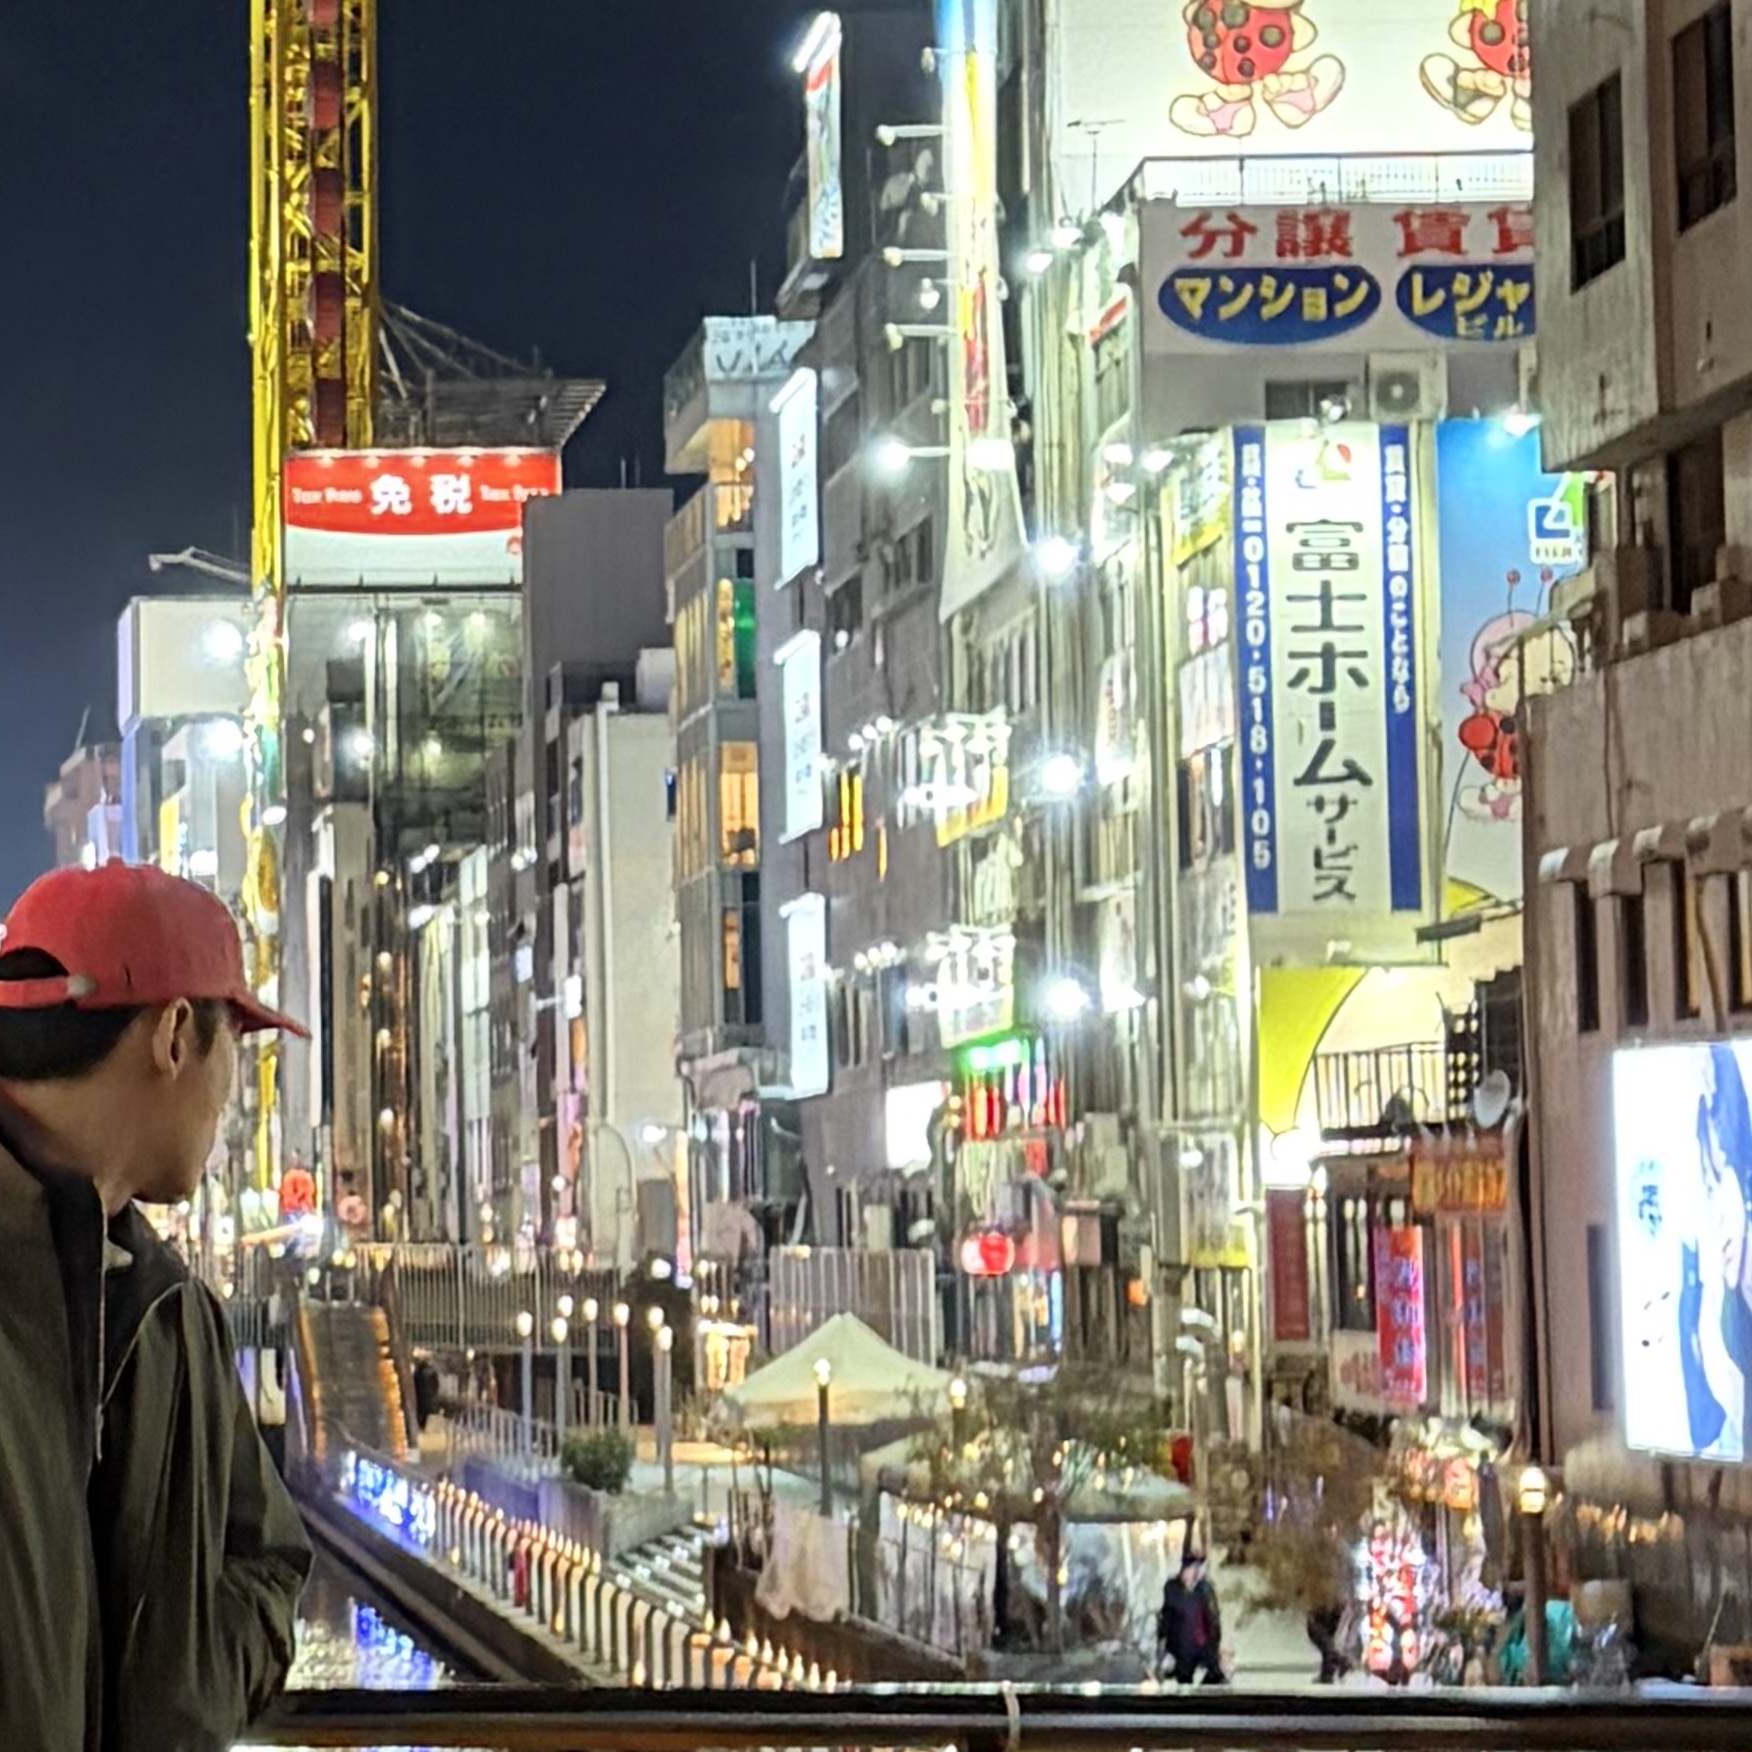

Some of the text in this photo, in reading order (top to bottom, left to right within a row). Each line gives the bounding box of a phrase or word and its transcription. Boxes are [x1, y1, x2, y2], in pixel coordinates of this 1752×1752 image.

[1174, 276, 1370, 322] マンション
[369, 474, 473, 515] 免税
[1286, 519, 1374, 902] 富士ホームサービス
